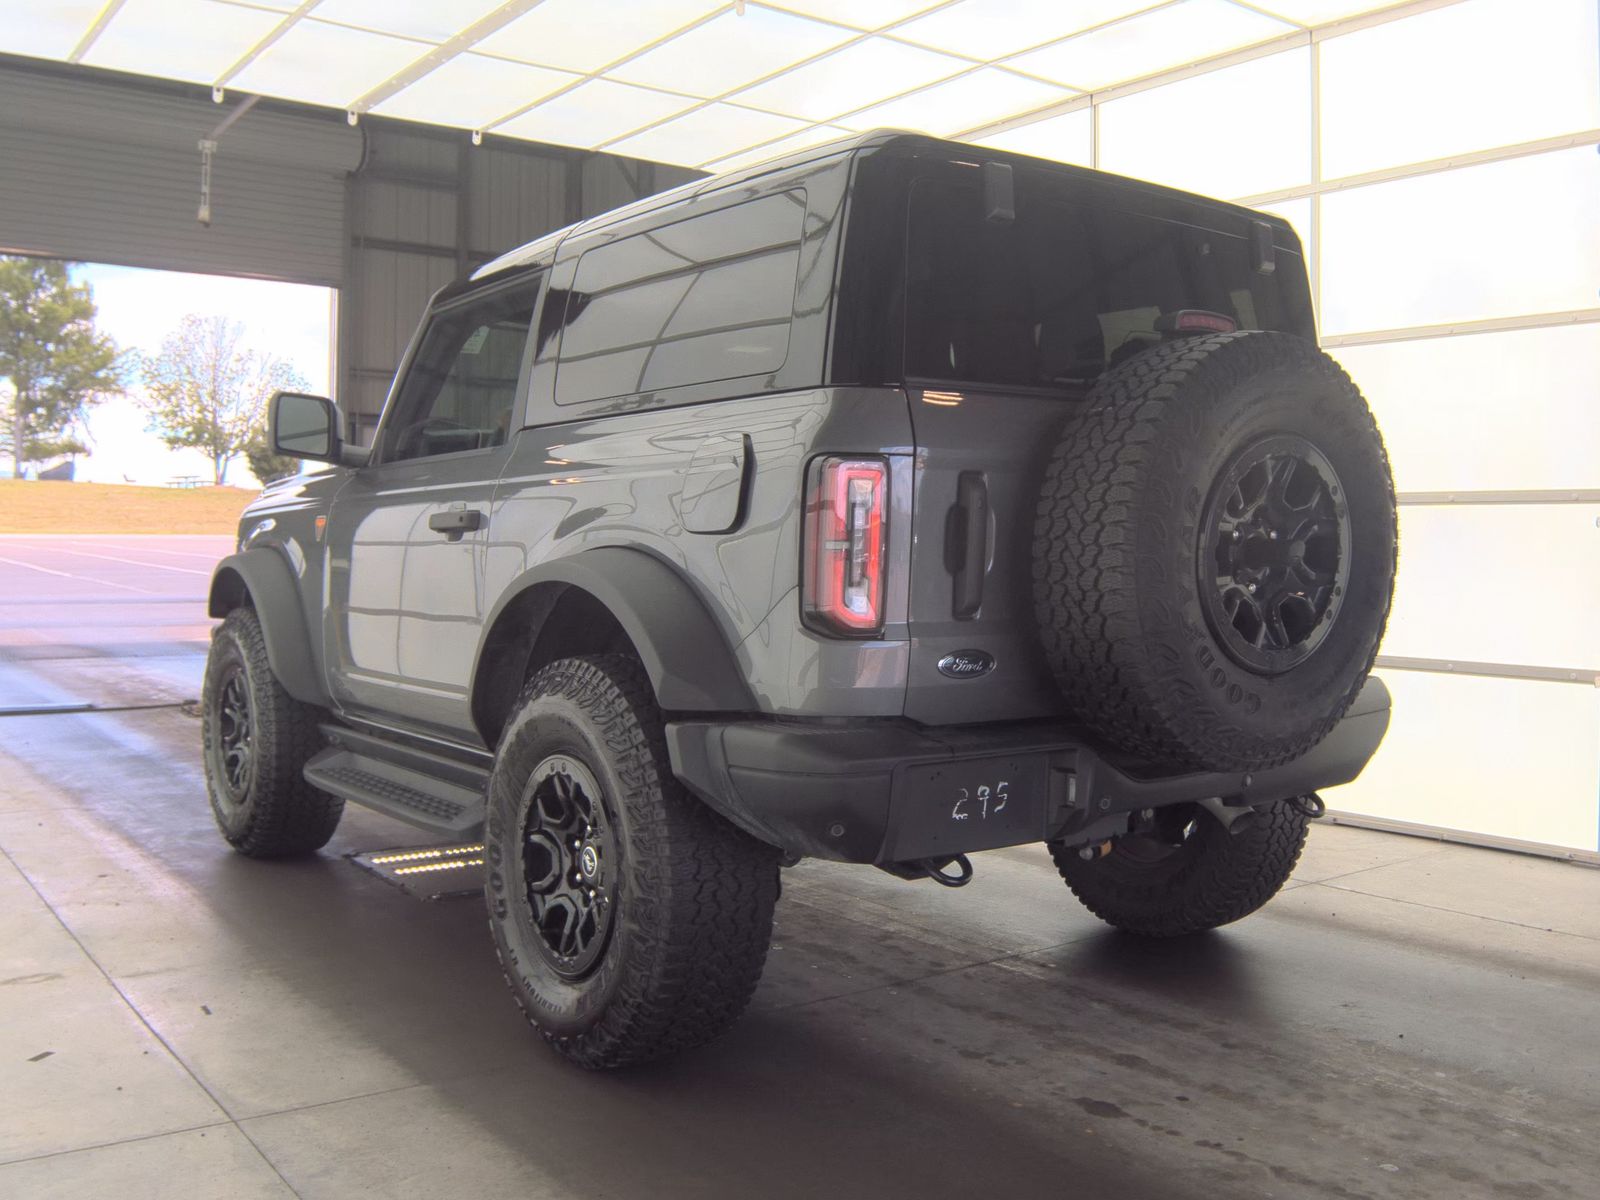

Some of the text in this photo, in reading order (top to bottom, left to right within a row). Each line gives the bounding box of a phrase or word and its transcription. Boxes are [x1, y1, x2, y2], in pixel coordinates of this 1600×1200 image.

[952, 657, 983, 672] Ford
[1197, 644, 1261, 715] GOOD
[952, 781, 1008, 820] 295
